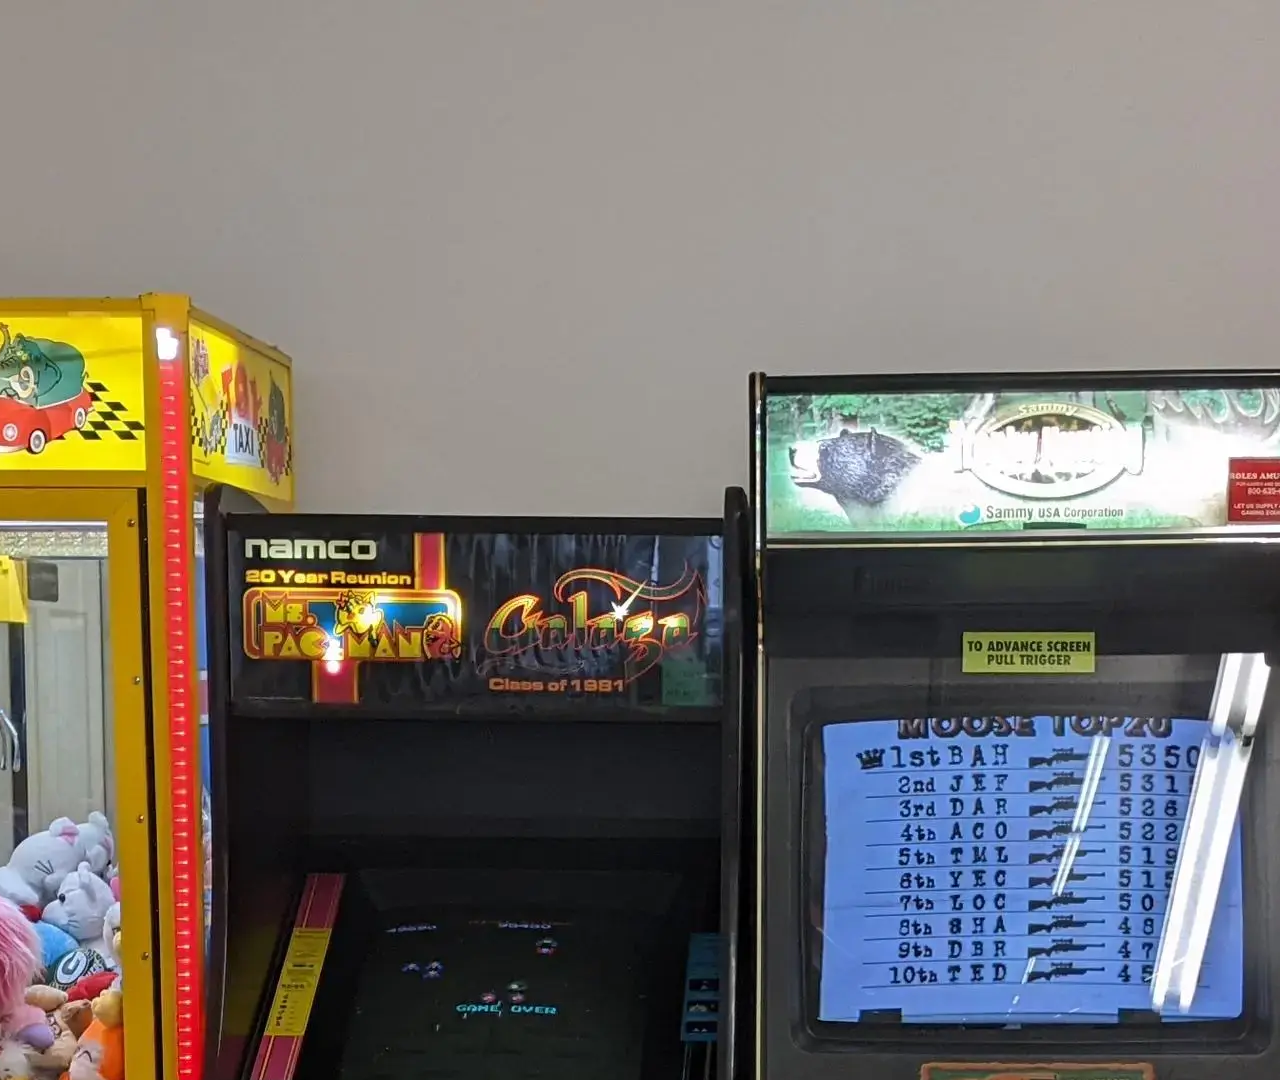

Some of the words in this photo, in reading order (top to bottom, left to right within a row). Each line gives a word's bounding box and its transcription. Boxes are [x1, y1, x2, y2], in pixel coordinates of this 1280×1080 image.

[221, 360, 263, 430] TOY
[1018, 402, 1078, 416] Sammy
[233, 423, 255, 456] TAXI
[986, 505, 1034, 520] Sammy
[1038, 507, 1060, 518] USA
[1063, 505, 1124, 519] Corporation
[245, 538, 377, 561] namco
[245, 569, 276, 583] 20
[278, 569, 328, 584] Year
[331, 570, 412, 585] Reunion
[261, 592, 317, 624] Ms.
[262, 626, 422, 658] PACMAN
[966, 640, 984, 653] TO
[986, 640, 1044, 653] ADVANCE
[1046, 640, 1092, 653] SCREEN
[986, 654, 1015, 667] PULL
[1018, 654, 1071, 667] TRIGGER
[489, 678, 544, 692] Class
[548, 678, 567, 692] of
[570, 678, 624, 692] 1981
[897, 716, 1036, 739] MOOSE
[890, 745, 941, 768] 1st
[898, 776, 936, 794] 2nd
[899, 800, 936, 818] 3rd
[900, 824, 936, 841] 4th
[898, 848, 935, 866] 5th
[900, 872, 935, 889] 6th
[900, 895, 934, 911] 7th
[899, 919, 932, 936] 8th
[898, 941, 932, 958] 9th
[889, 965, 938, 984] 10th
[455, 1003, 501, 1013] GAME
[510, 1005, 557, 1015] OVER
